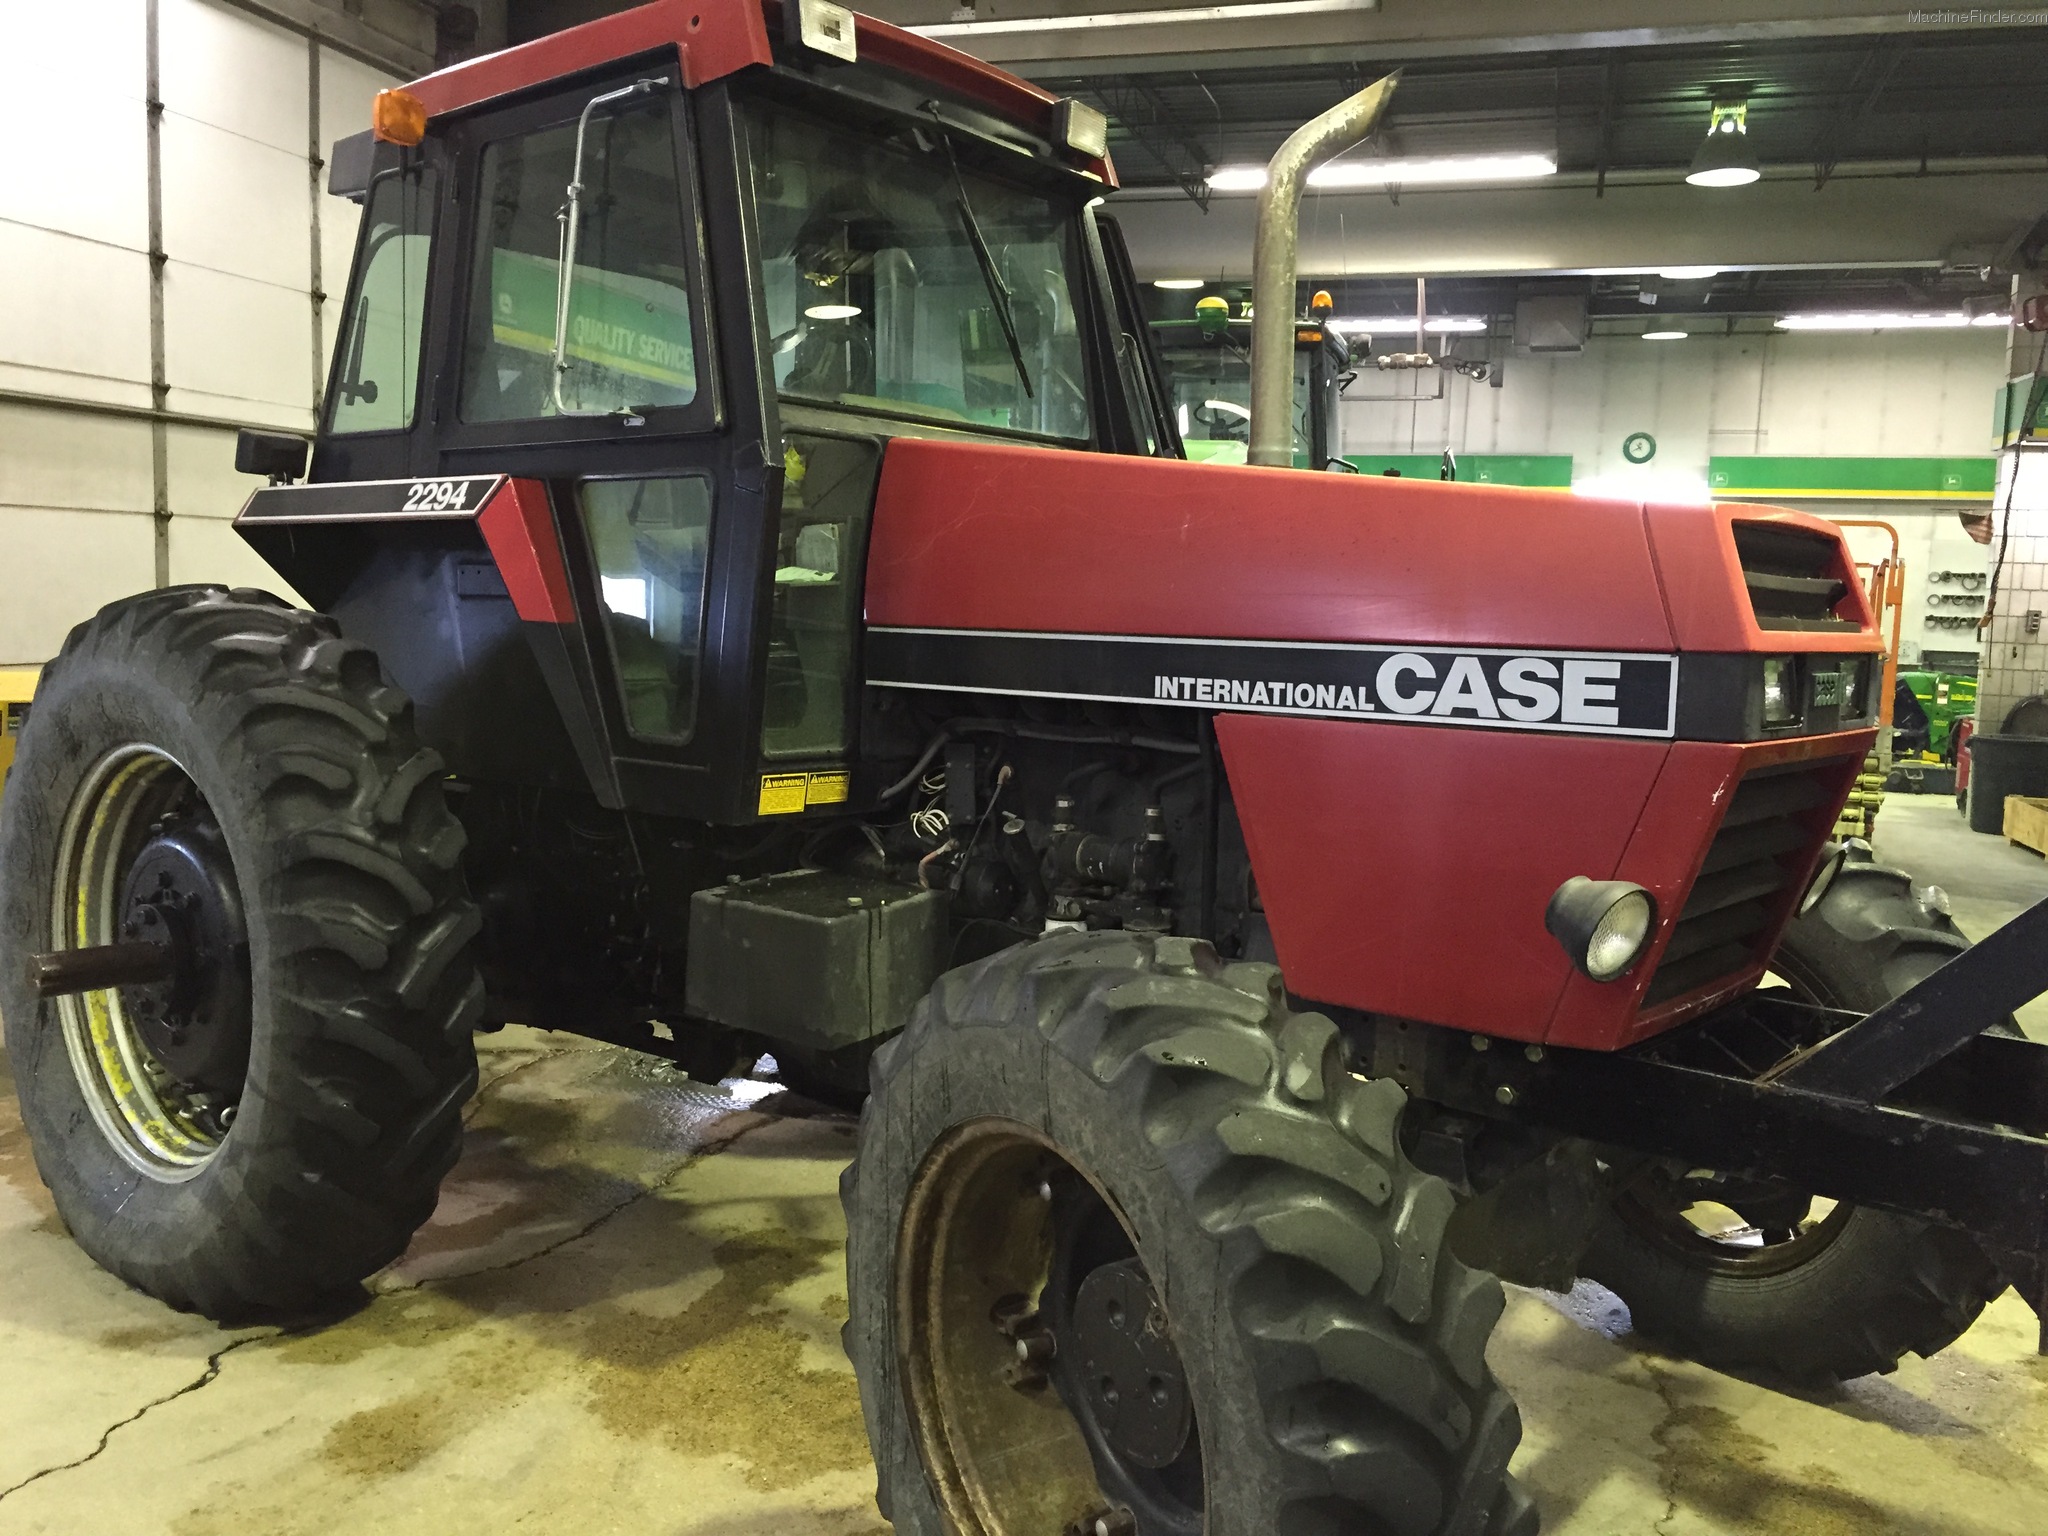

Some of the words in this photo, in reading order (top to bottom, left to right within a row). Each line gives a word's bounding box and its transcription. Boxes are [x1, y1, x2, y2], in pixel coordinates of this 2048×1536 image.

[573, 315, 637, 355] QUALITY
[638, 333, 692, 371] SERVICE
[402, 481, 470, 511] 2294
[1154, 675, 1375, 711] INTERNATIONAL
[1375, 652, 1621, 725] CASE
[772, 778, 805, 788] WARNING
